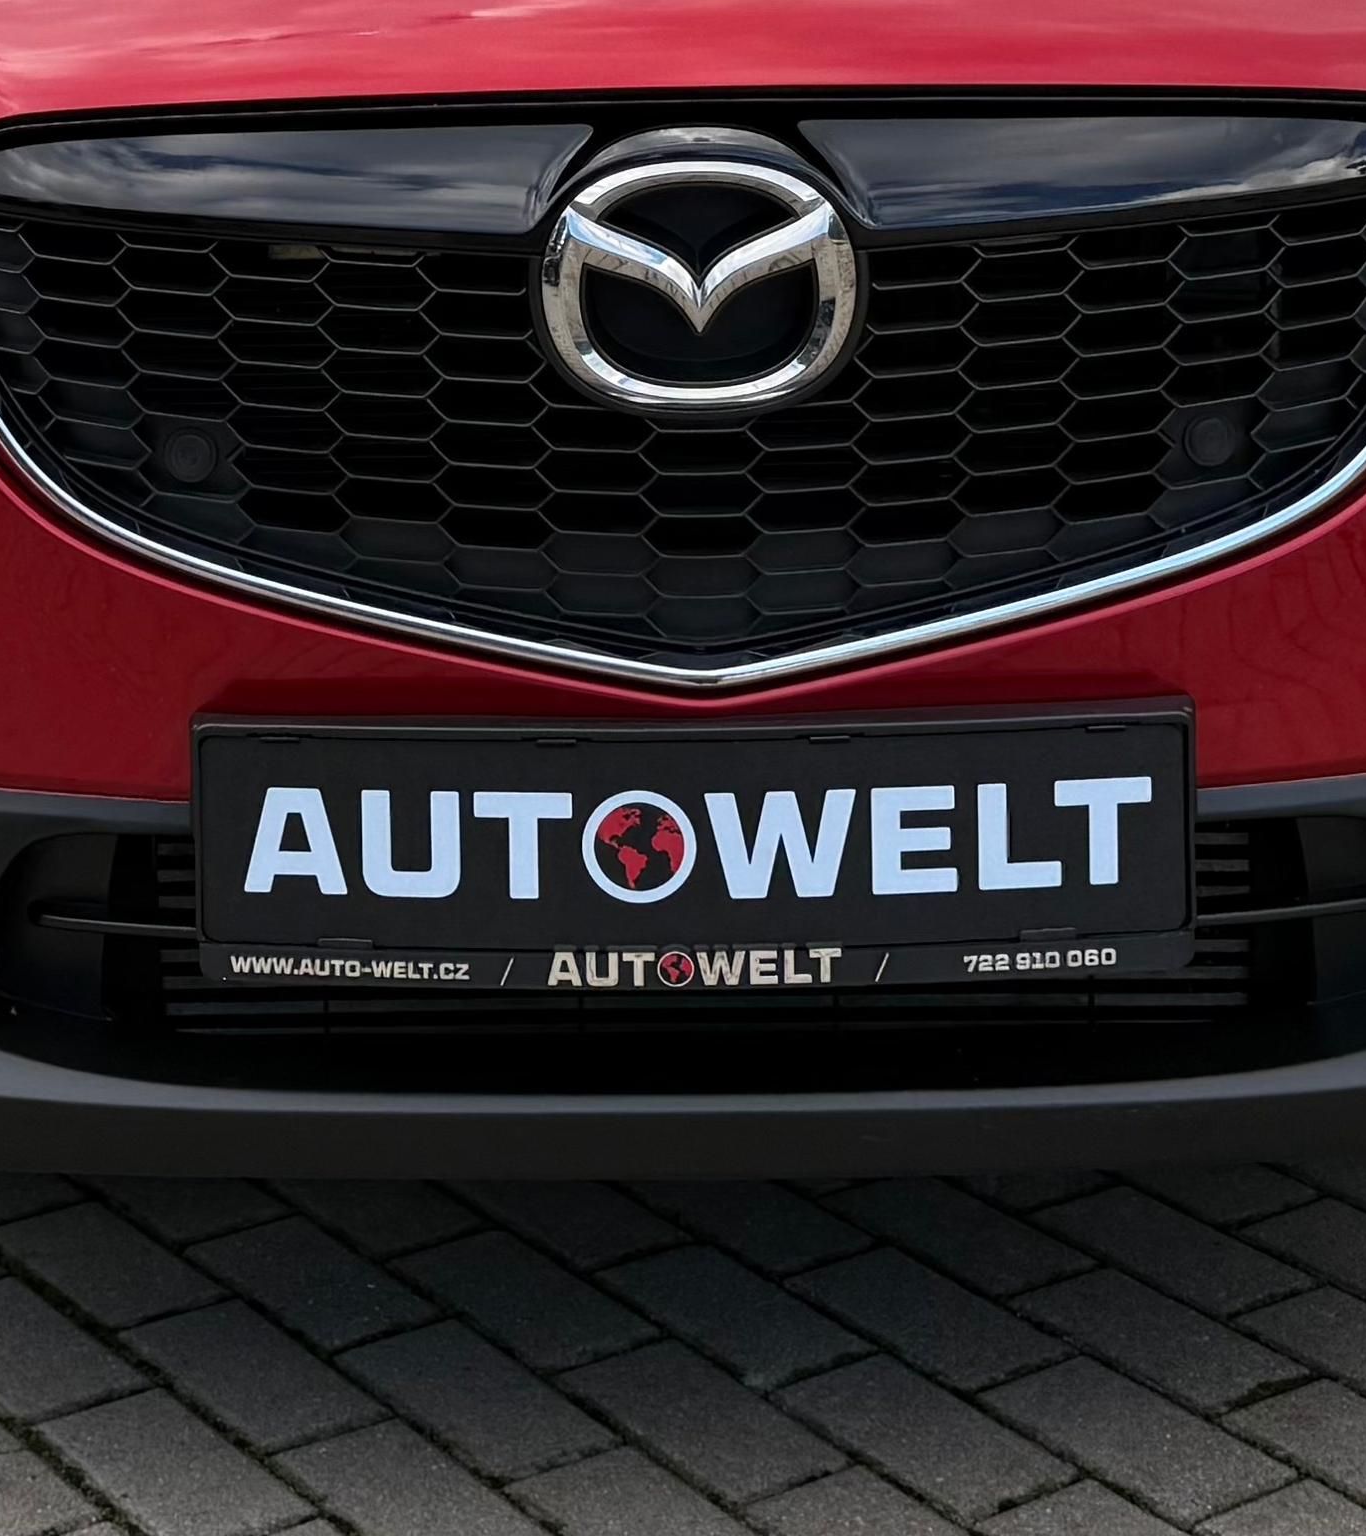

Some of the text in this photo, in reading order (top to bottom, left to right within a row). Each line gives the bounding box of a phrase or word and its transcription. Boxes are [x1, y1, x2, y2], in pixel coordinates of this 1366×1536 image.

[243, 776, 1153, 904] AUTOWELT
[230, 955, 470, 980] WWW.AUTO-WELT.CZ
[547, 947, 842, 988] AUTOWELT
[963, 954, 1010, 973] 722
[1016, 951, 1060, 970] 910
[1066, 948, 1117, 967] 060
